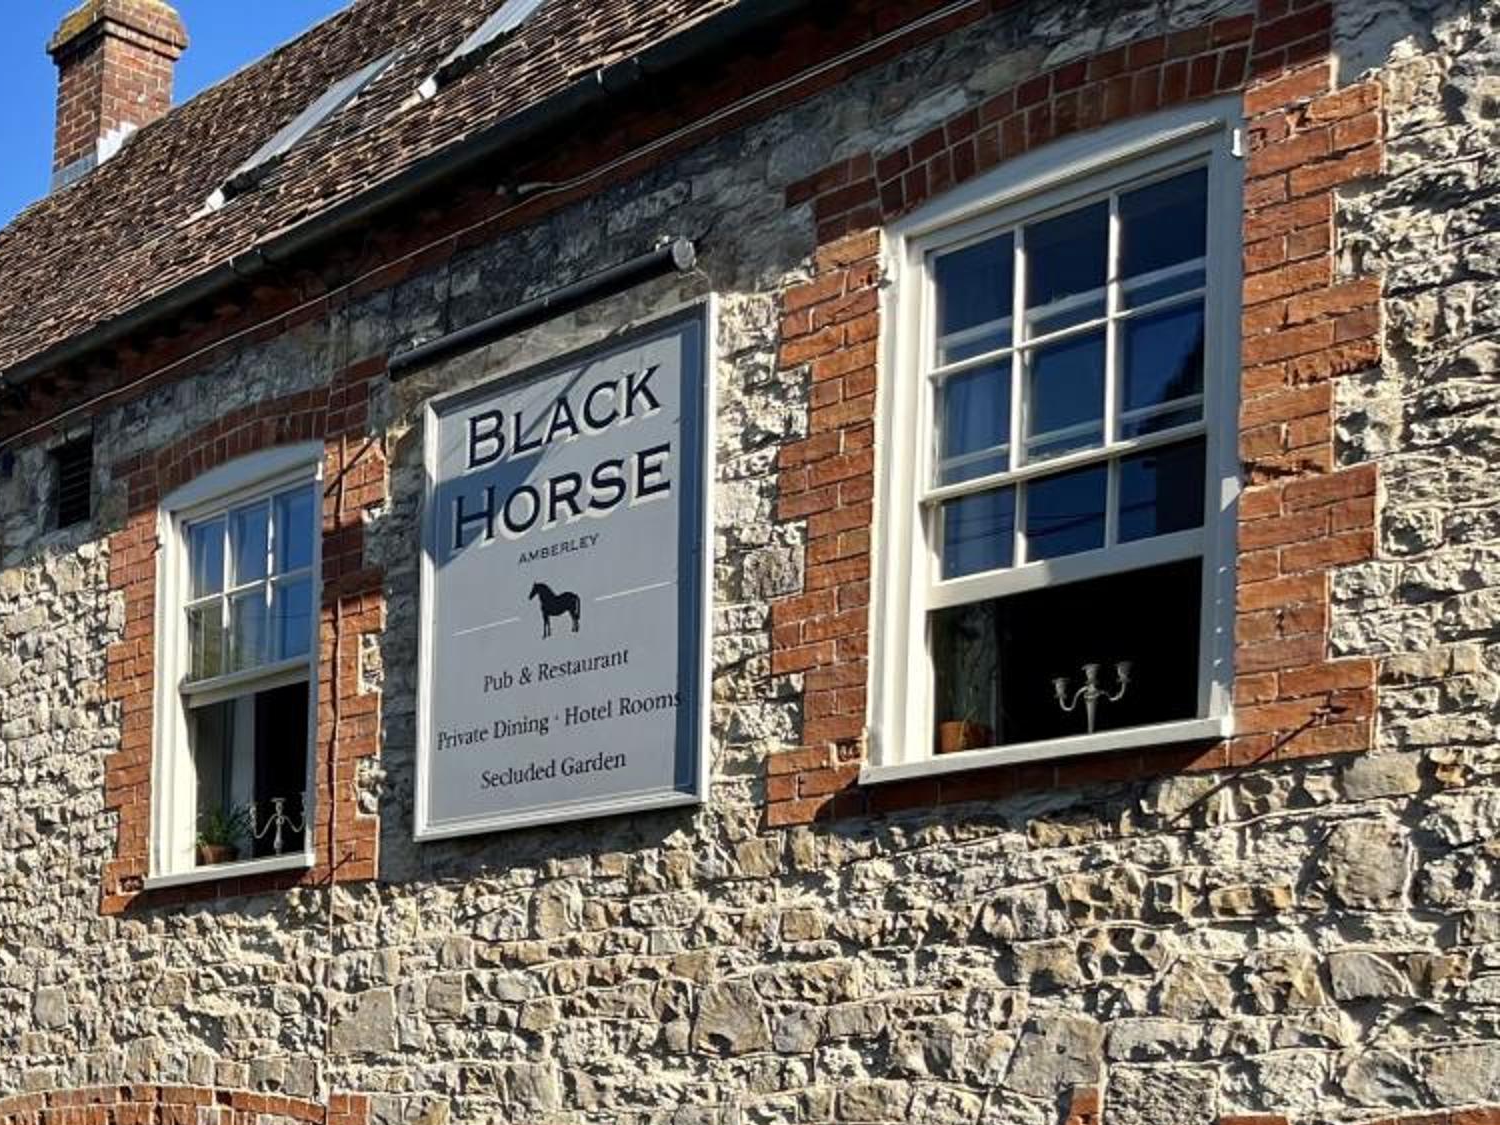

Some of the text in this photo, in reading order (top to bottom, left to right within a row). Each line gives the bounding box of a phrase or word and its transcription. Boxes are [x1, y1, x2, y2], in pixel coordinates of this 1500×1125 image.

[467, 365, 660, 470] BLACK
[453, 442, 671, 550] HORSE
[518, 533, 599, 564] AMBERLEY
[483, 649, 628, 692] Pub & Restaurant
[437, 691, 681, 750] Private Dining Hotel Rooms
[481, 752, 627, 789] Secluded Garden
